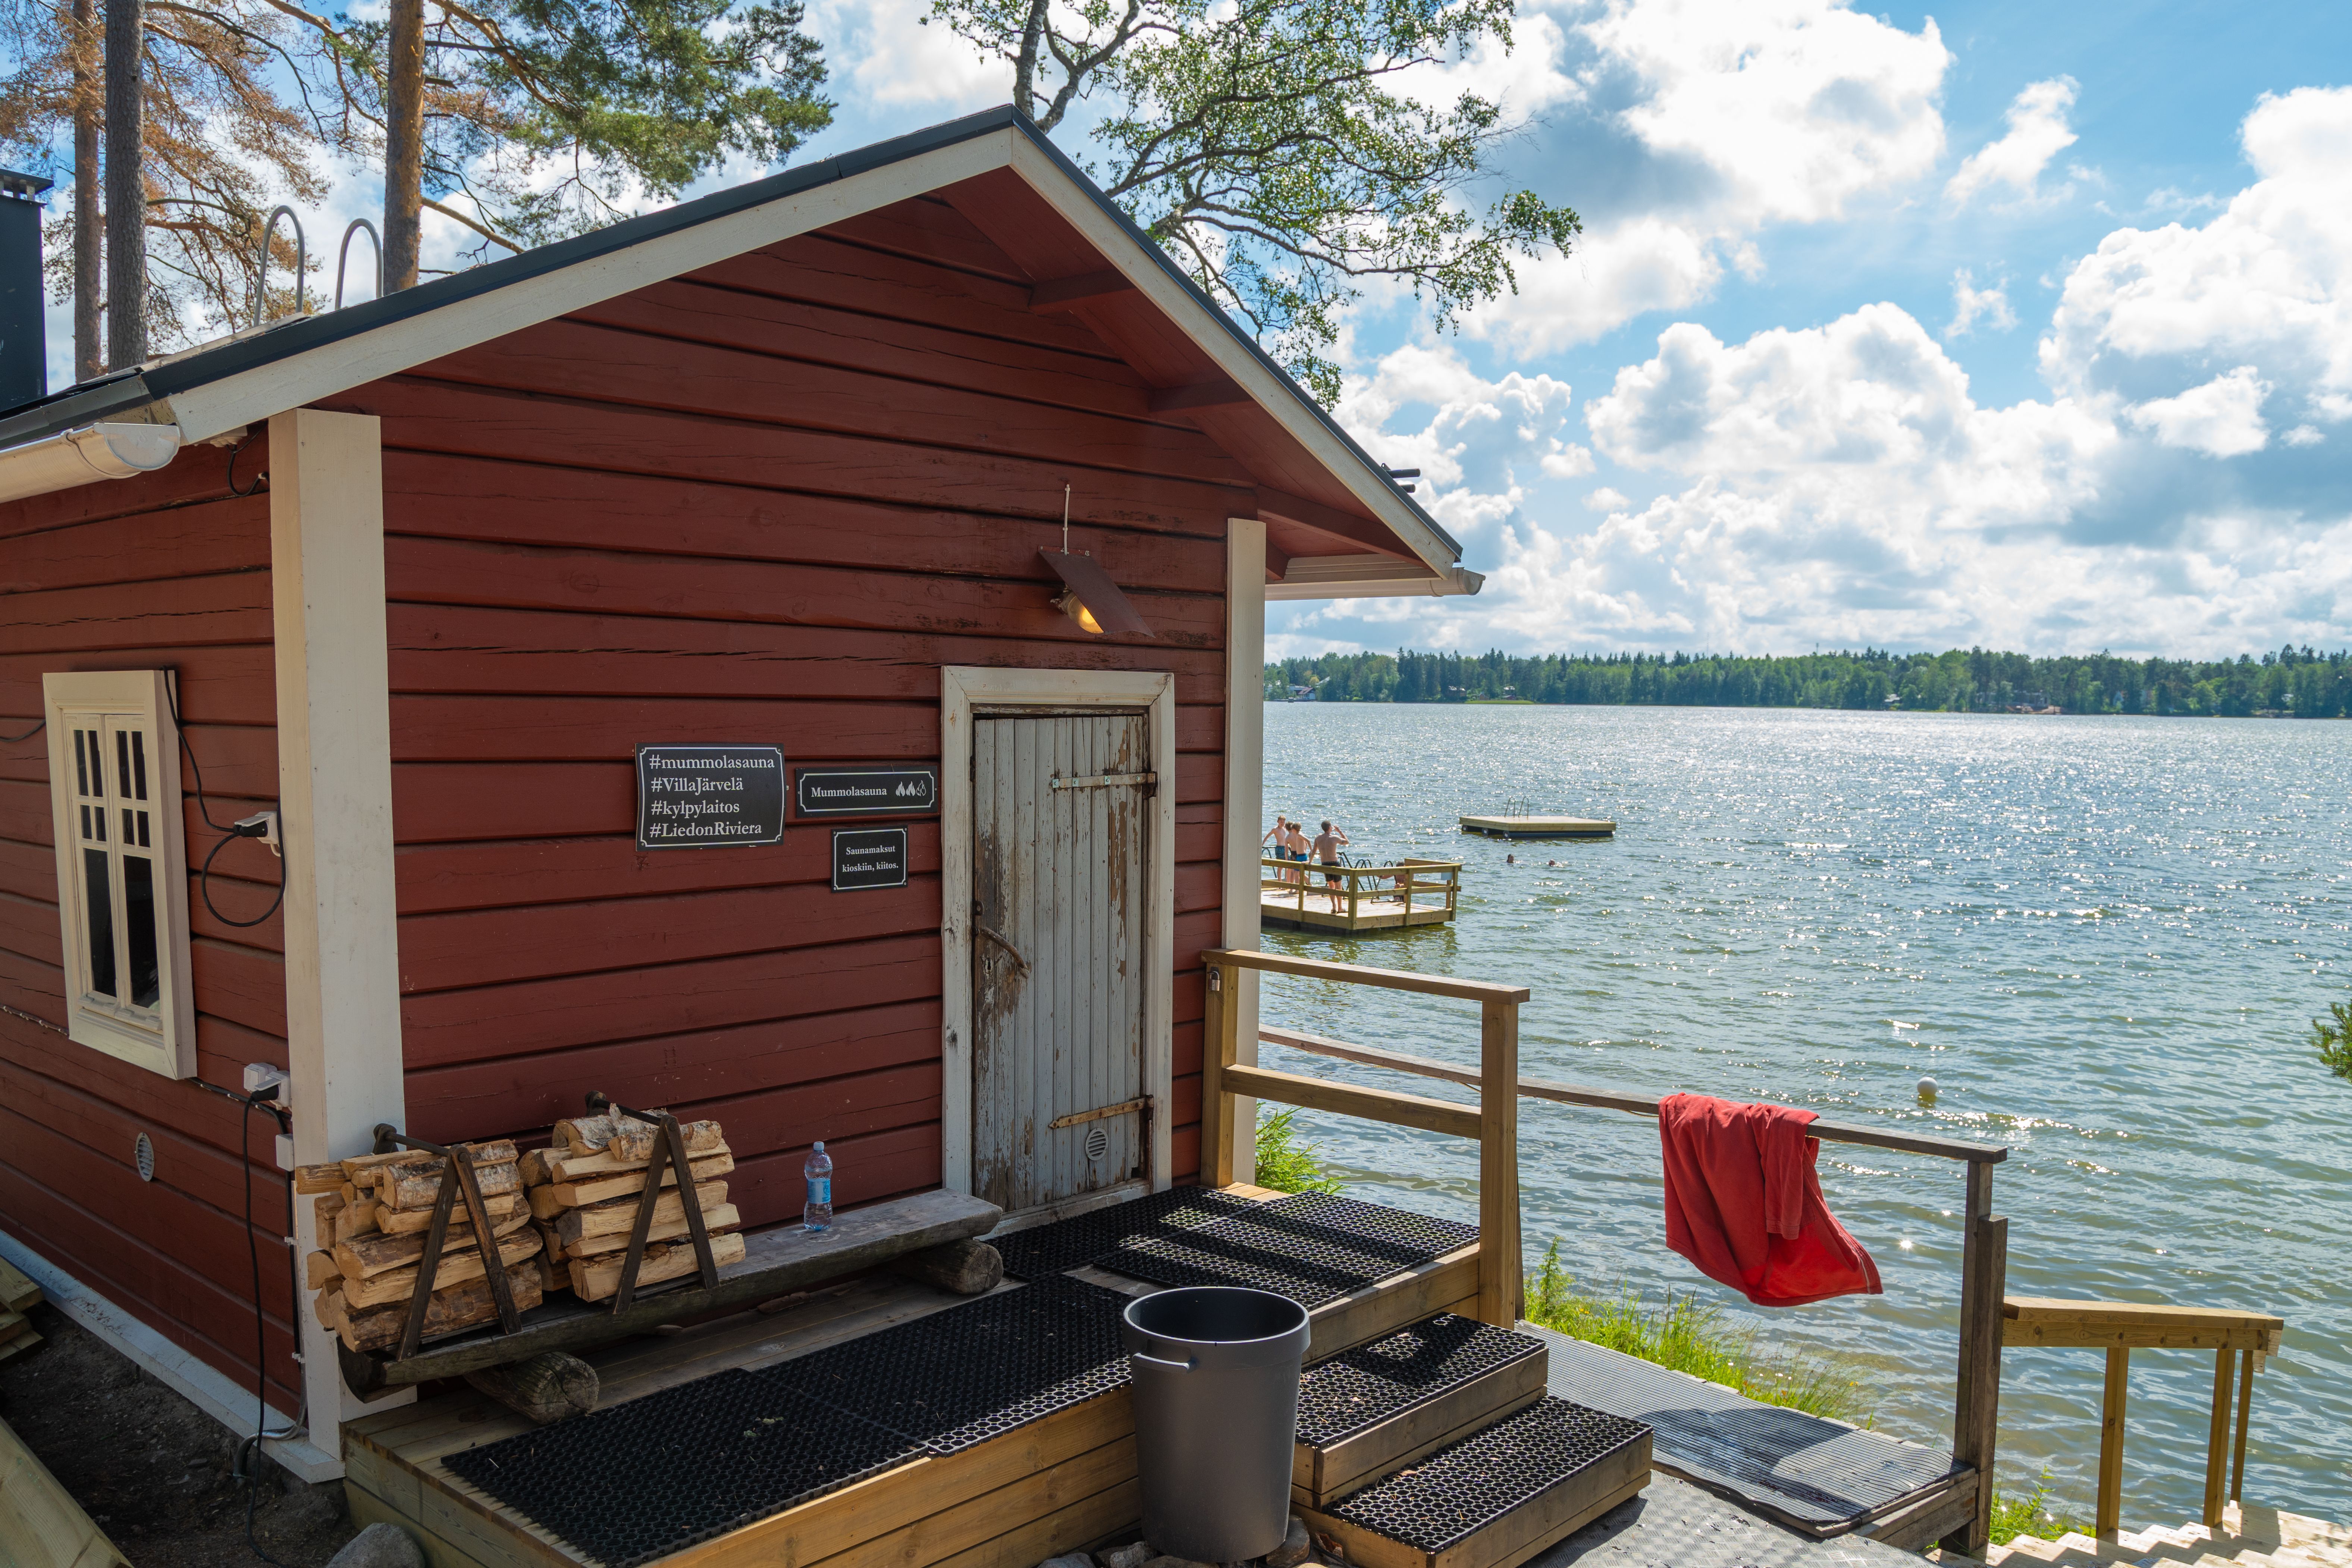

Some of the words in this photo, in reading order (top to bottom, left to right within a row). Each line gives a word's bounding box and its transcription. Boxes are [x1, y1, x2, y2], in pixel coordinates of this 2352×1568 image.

[649, 754, 775, 769] #mummolasauna
[651, 777, 744, 796] #VillaJärvelä
[811, 786, 887, 797] Mummolasauna
[651, 799, 740, 819] #kylpylaitos
[650, 821, 762, 838] #LiedonRiviera
[846, 845, 896, 855] Saunamaksut
[842, 862, 875, 872] kioskiin,
[876, 862, 899, 870] kiitos.
